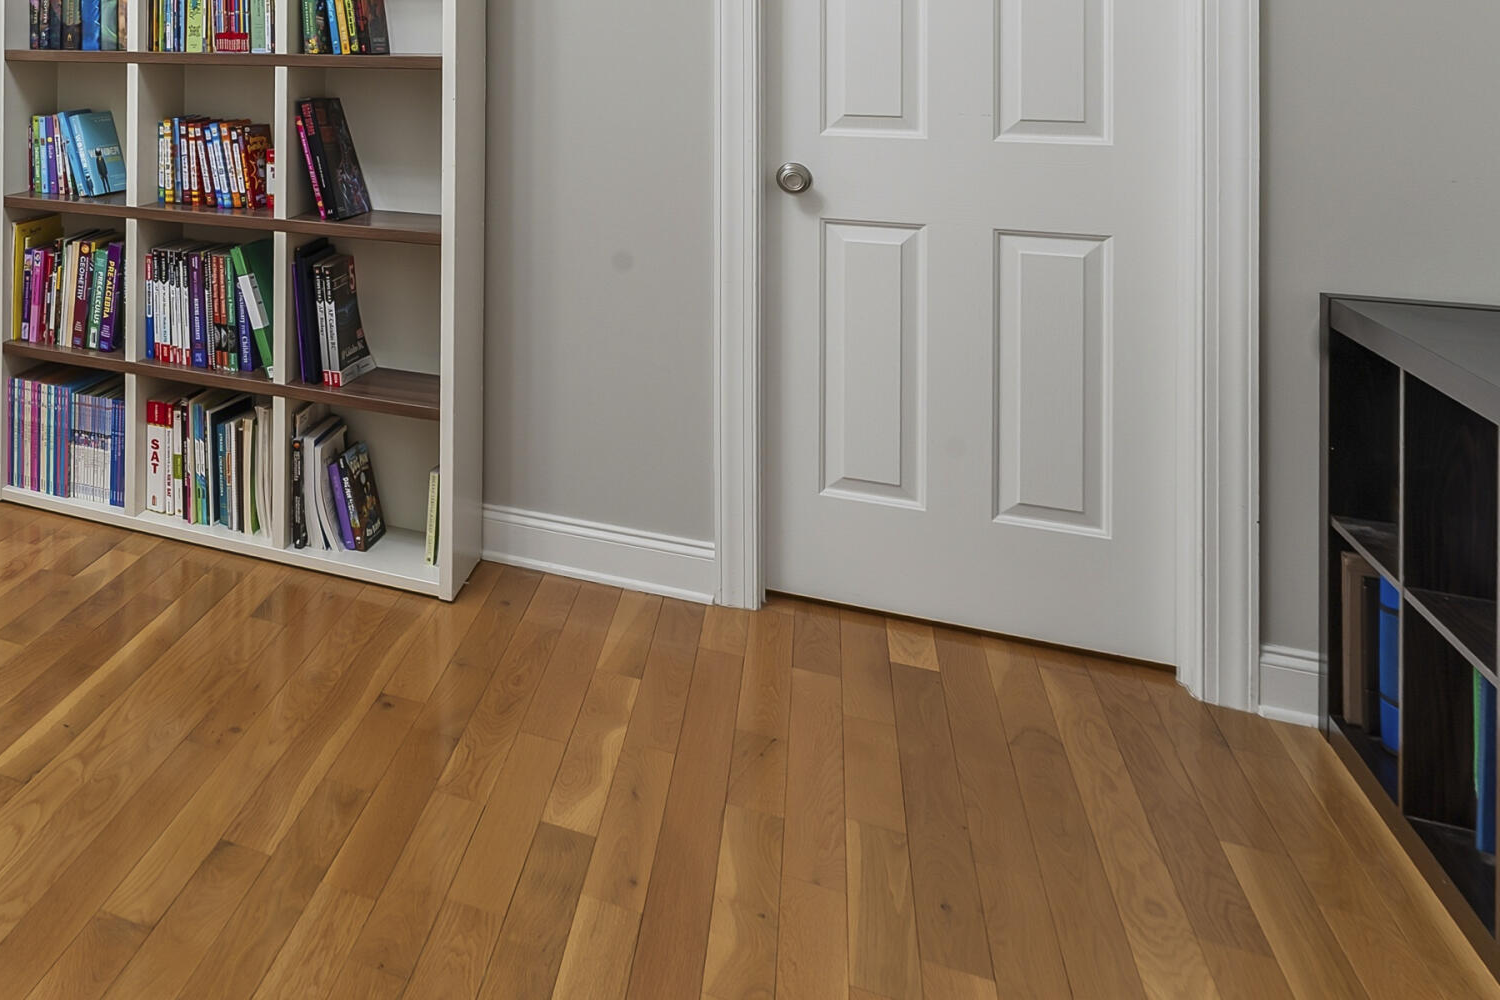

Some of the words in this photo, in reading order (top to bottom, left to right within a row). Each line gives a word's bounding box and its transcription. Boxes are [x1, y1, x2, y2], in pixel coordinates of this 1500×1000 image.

[77, 256, 86, 300] GEOMETRY
[93, 271, 104, 324] PRECALCULUS
[151, 439, 160, 474] SAT
